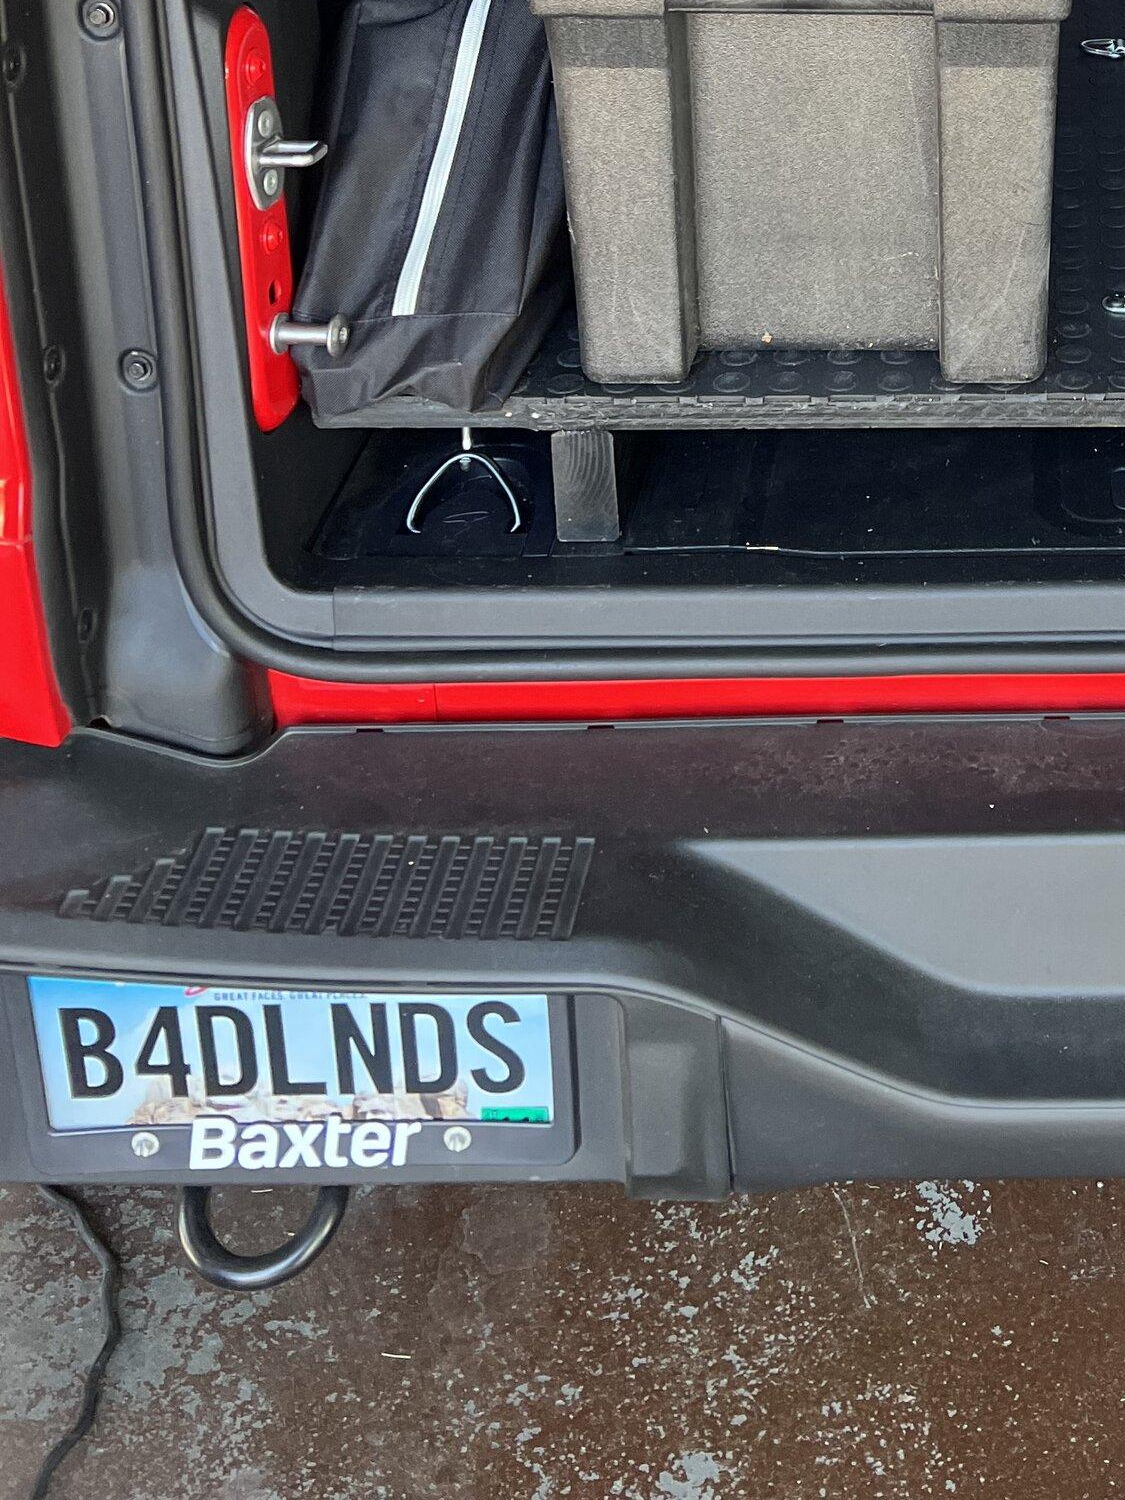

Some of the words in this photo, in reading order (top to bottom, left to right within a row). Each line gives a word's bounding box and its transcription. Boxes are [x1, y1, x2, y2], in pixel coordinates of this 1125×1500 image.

[214, 991, 247, 1001] GREAT
[252, 991, 286, 1001] FACES.
[289, 990, 323, 1000] GREAT
[58, 1001, 526, 1099] B4DLNDS
[189, 1114, 424, 1170] Baxter
